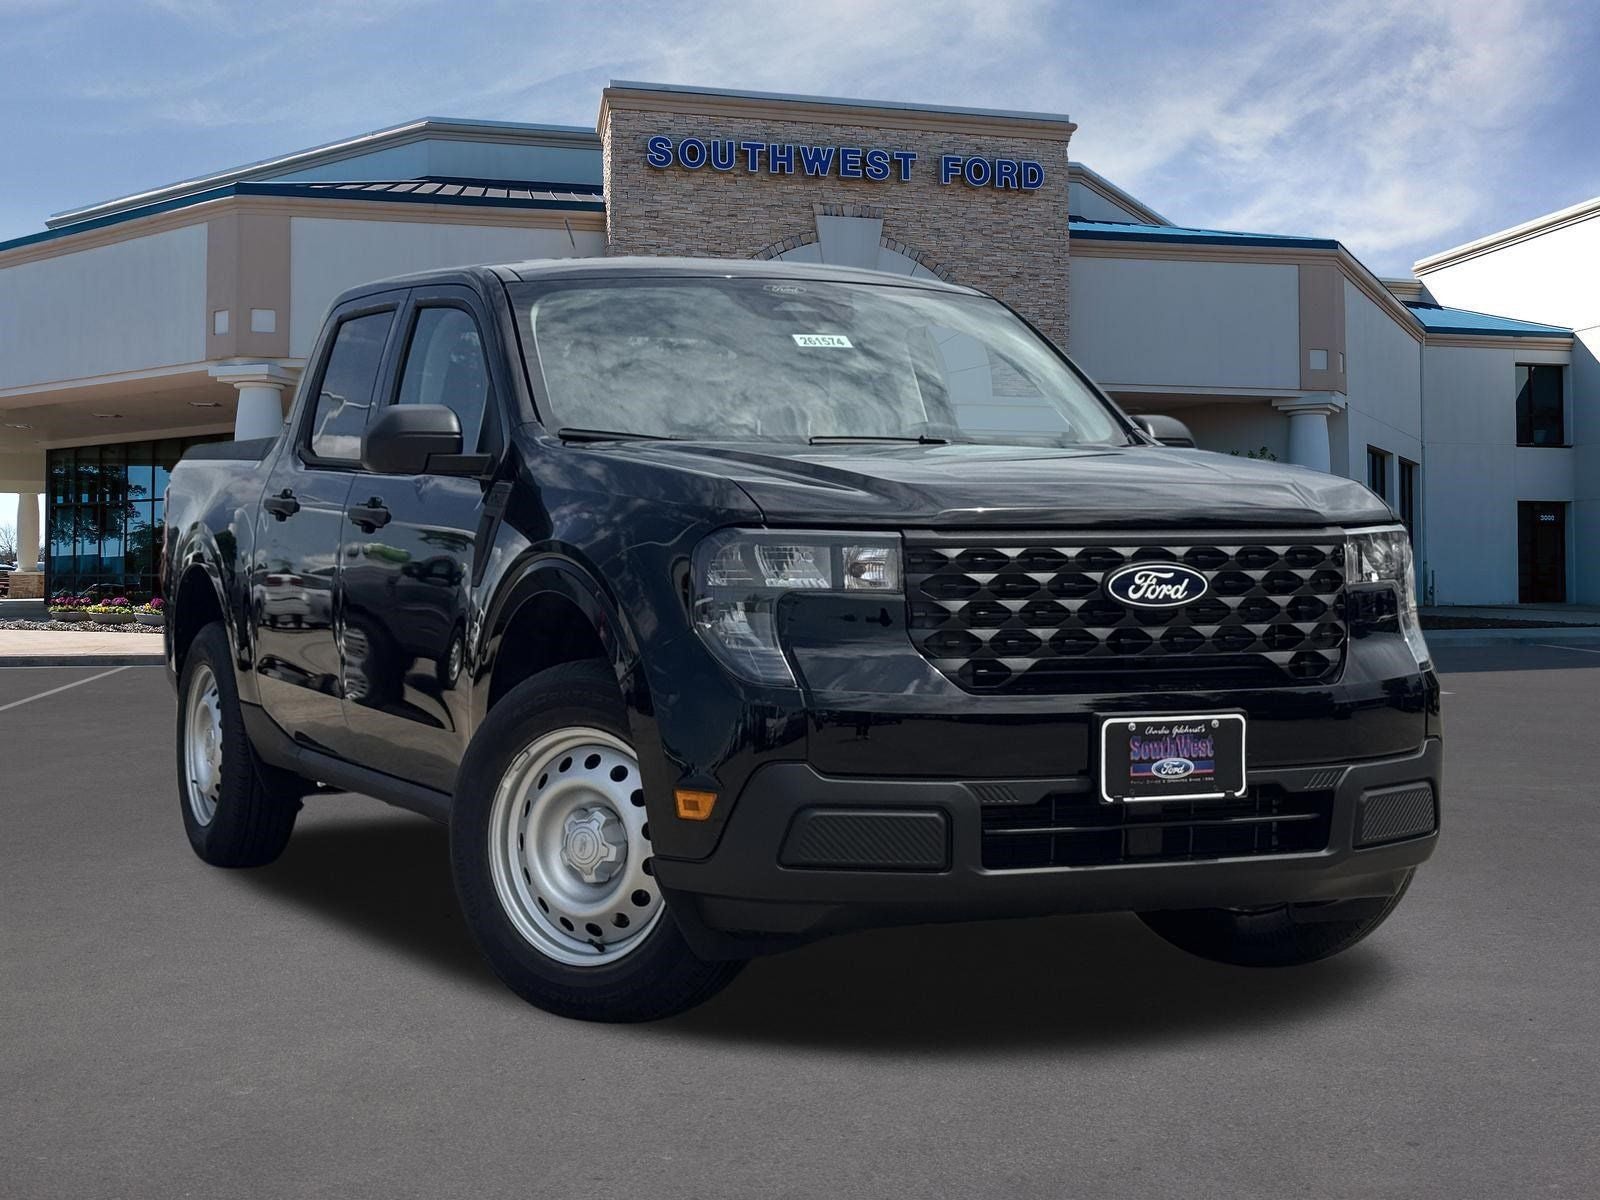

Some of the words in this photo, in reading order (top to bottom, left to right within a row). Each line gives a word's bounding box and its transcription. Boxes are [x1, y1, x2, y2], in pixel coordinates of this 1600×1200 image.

[646, 135, 918, 182] SOUTHWEST
[940, 154, 1045, 191] FORD
[799, 336, 846, 347] 261574
[1127, 570, 1190, 600] Ford
[1160, 761, 1186, 775] Ford
